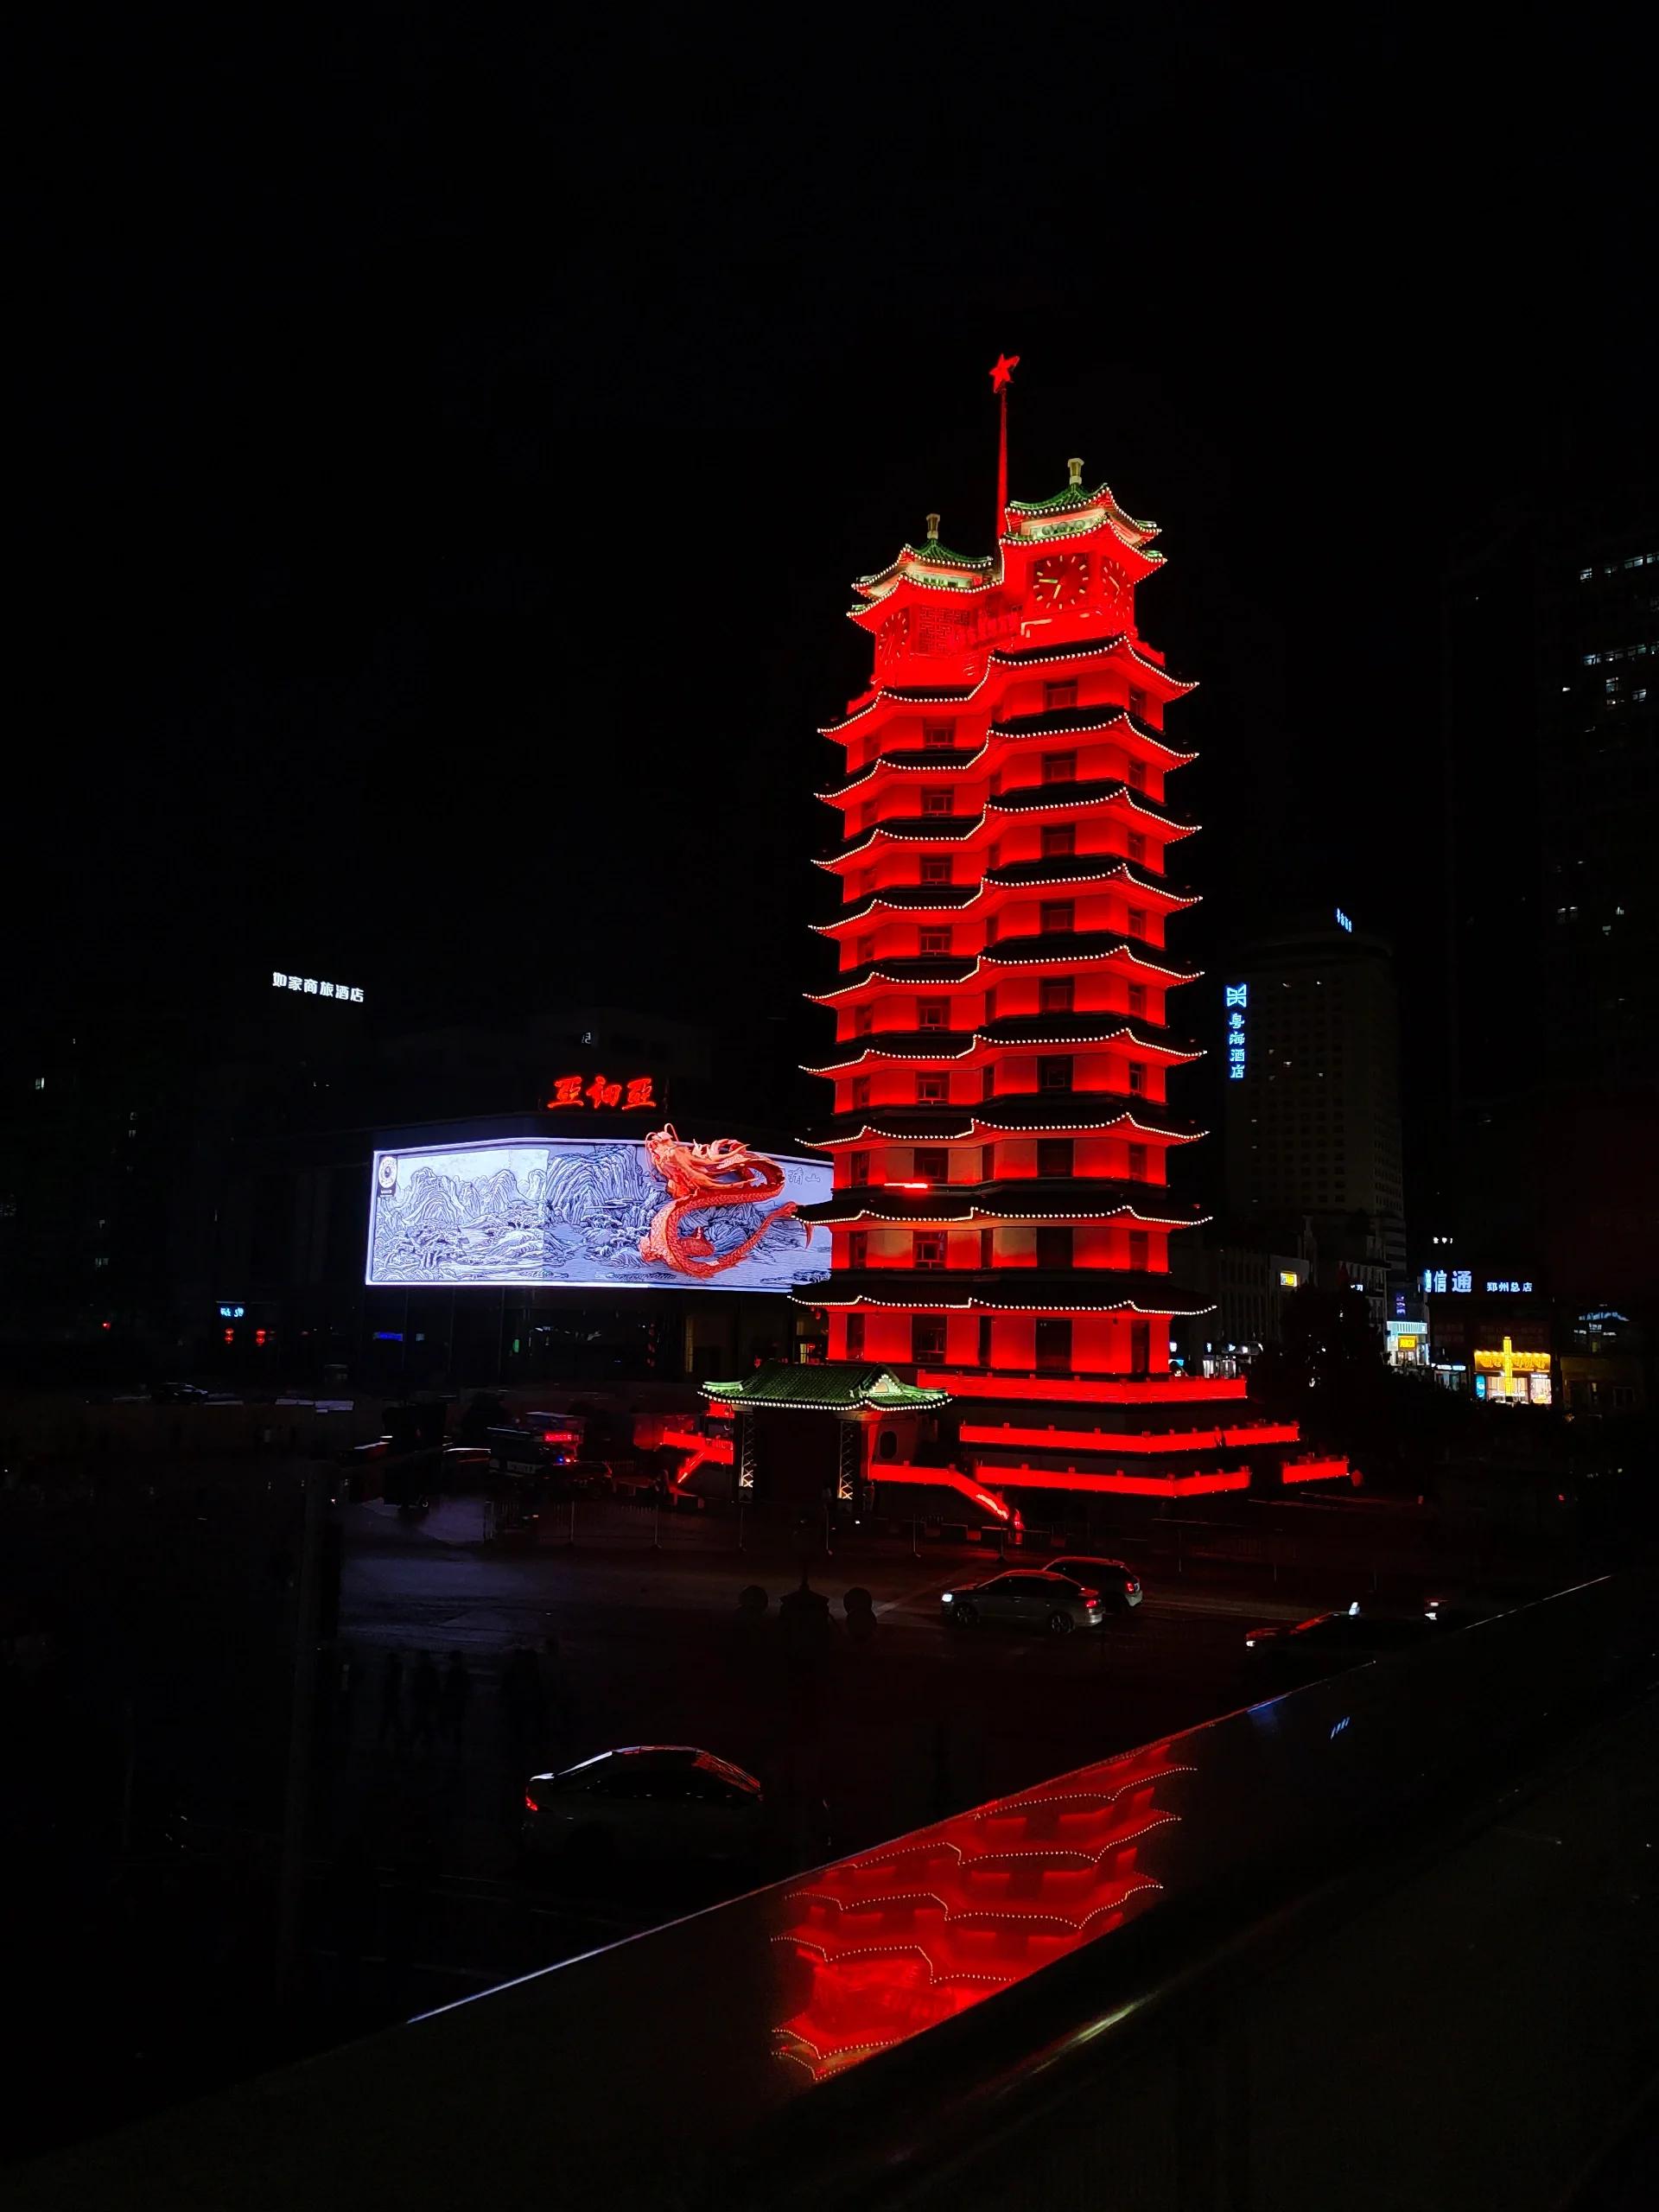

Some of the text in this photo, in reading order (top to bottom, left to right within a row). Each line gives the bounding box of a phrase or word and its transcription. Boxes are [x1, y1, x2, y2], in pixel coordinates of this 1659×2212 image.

[272, 971, 365, 1003] 如家商旅酒店
[1486, 1281, 1533, 1293] 郑州总店
